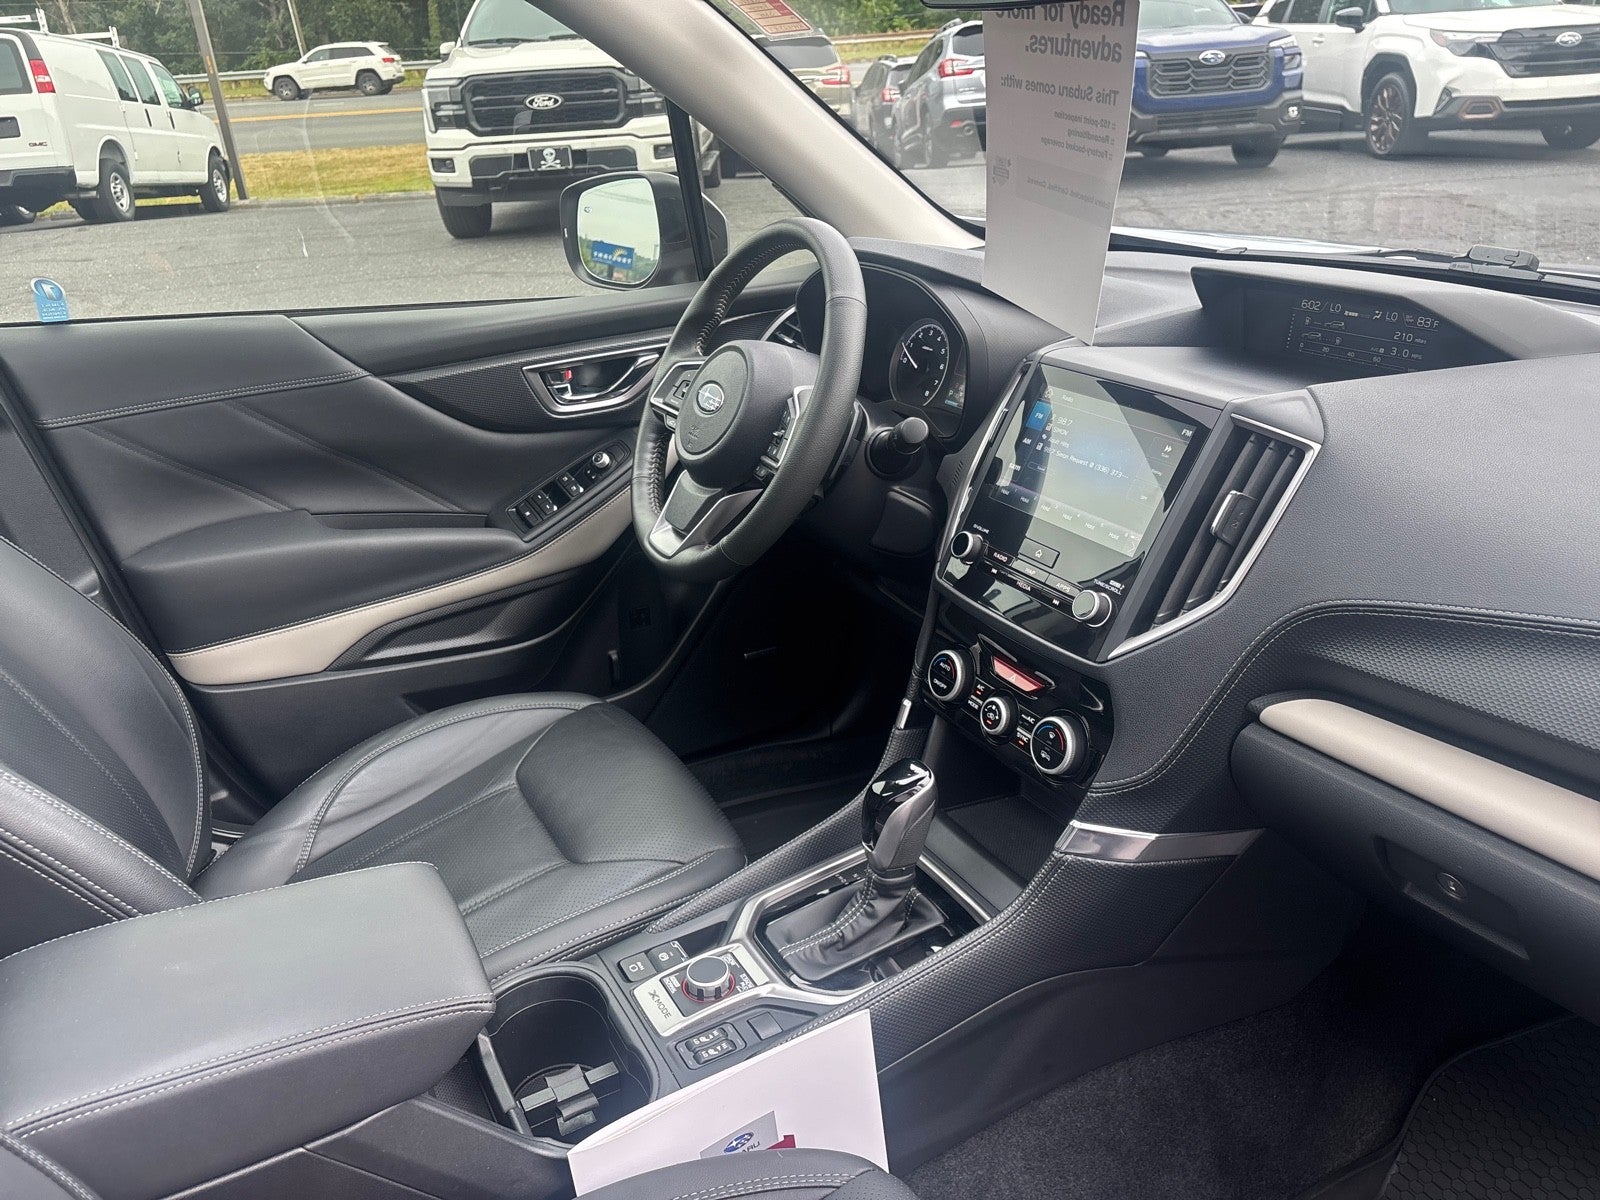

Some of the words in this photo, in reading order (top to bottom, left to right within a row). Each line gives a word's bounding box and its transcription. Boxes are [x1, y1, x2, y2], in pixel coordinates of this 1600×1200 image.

[532, 96, 555, 107] Ford
[1330, 303, 1342, 313] LO
[1385, 311, 1399, 321] LO
[1393, 331, 1414, 342] 210
[1390, 346, 1410, 358] 3.0
[1034, 412, 1044, 420] FM
[1181, 428, 1193, 438] FM
[1022, 437, 1032, 446] AM
[993, 552, 1008, 563] RADIO
[1016, 580, 1031, 592] MEDIA
[1055, 582, 1070, 593] APPS
[940, 661, 951, 672] AUTO
